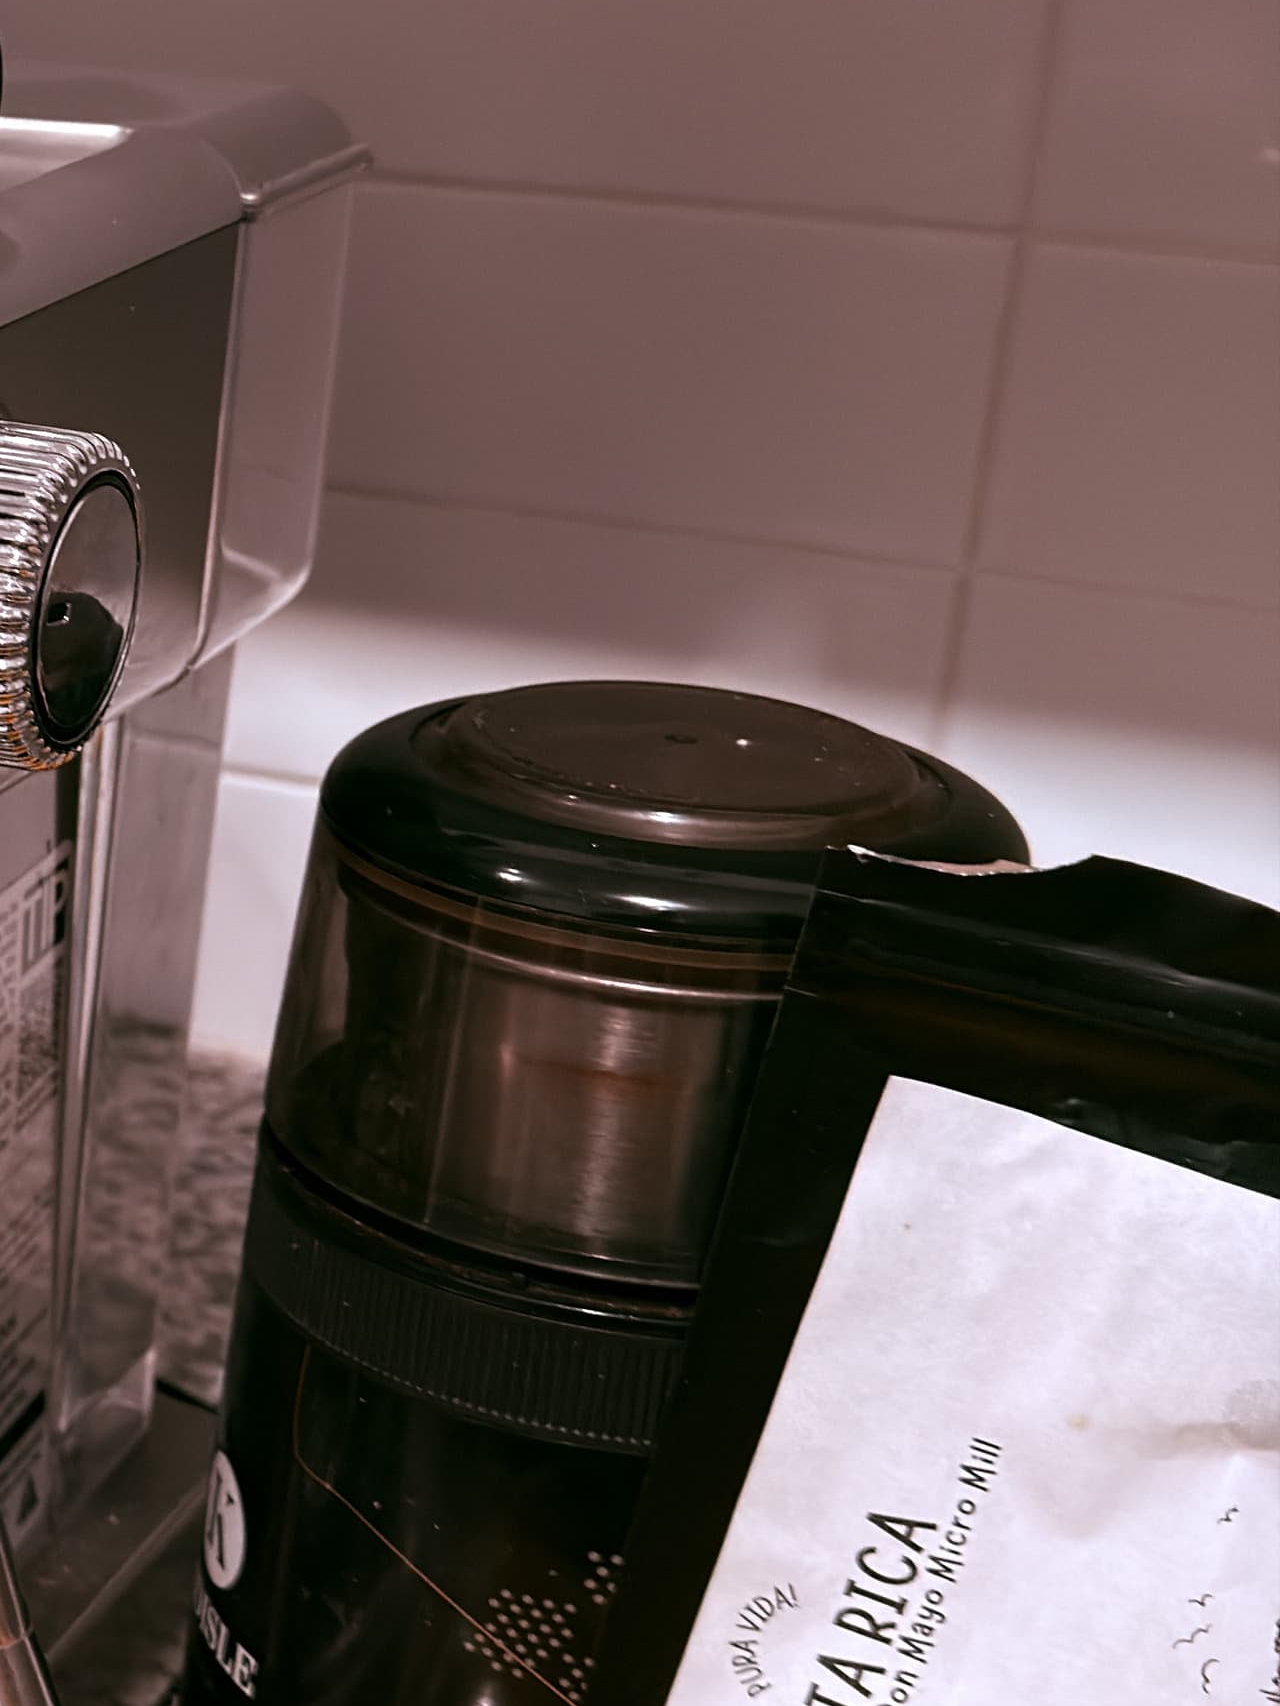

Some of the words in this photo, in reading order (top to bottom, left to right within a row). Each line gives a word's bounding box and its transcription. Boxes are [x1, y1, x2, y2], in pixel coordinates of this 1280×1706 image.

[832, 1511, 938, 1646] RICA
[896, 1588, 947, 1664] Mayo
[925, 1497, 977, 1583] Micro
[957, 1436, 1004, 1493] Mill
[736, 1583, 800, 1633] VIDA!
[729, 1638, 772, 1698] PURA
